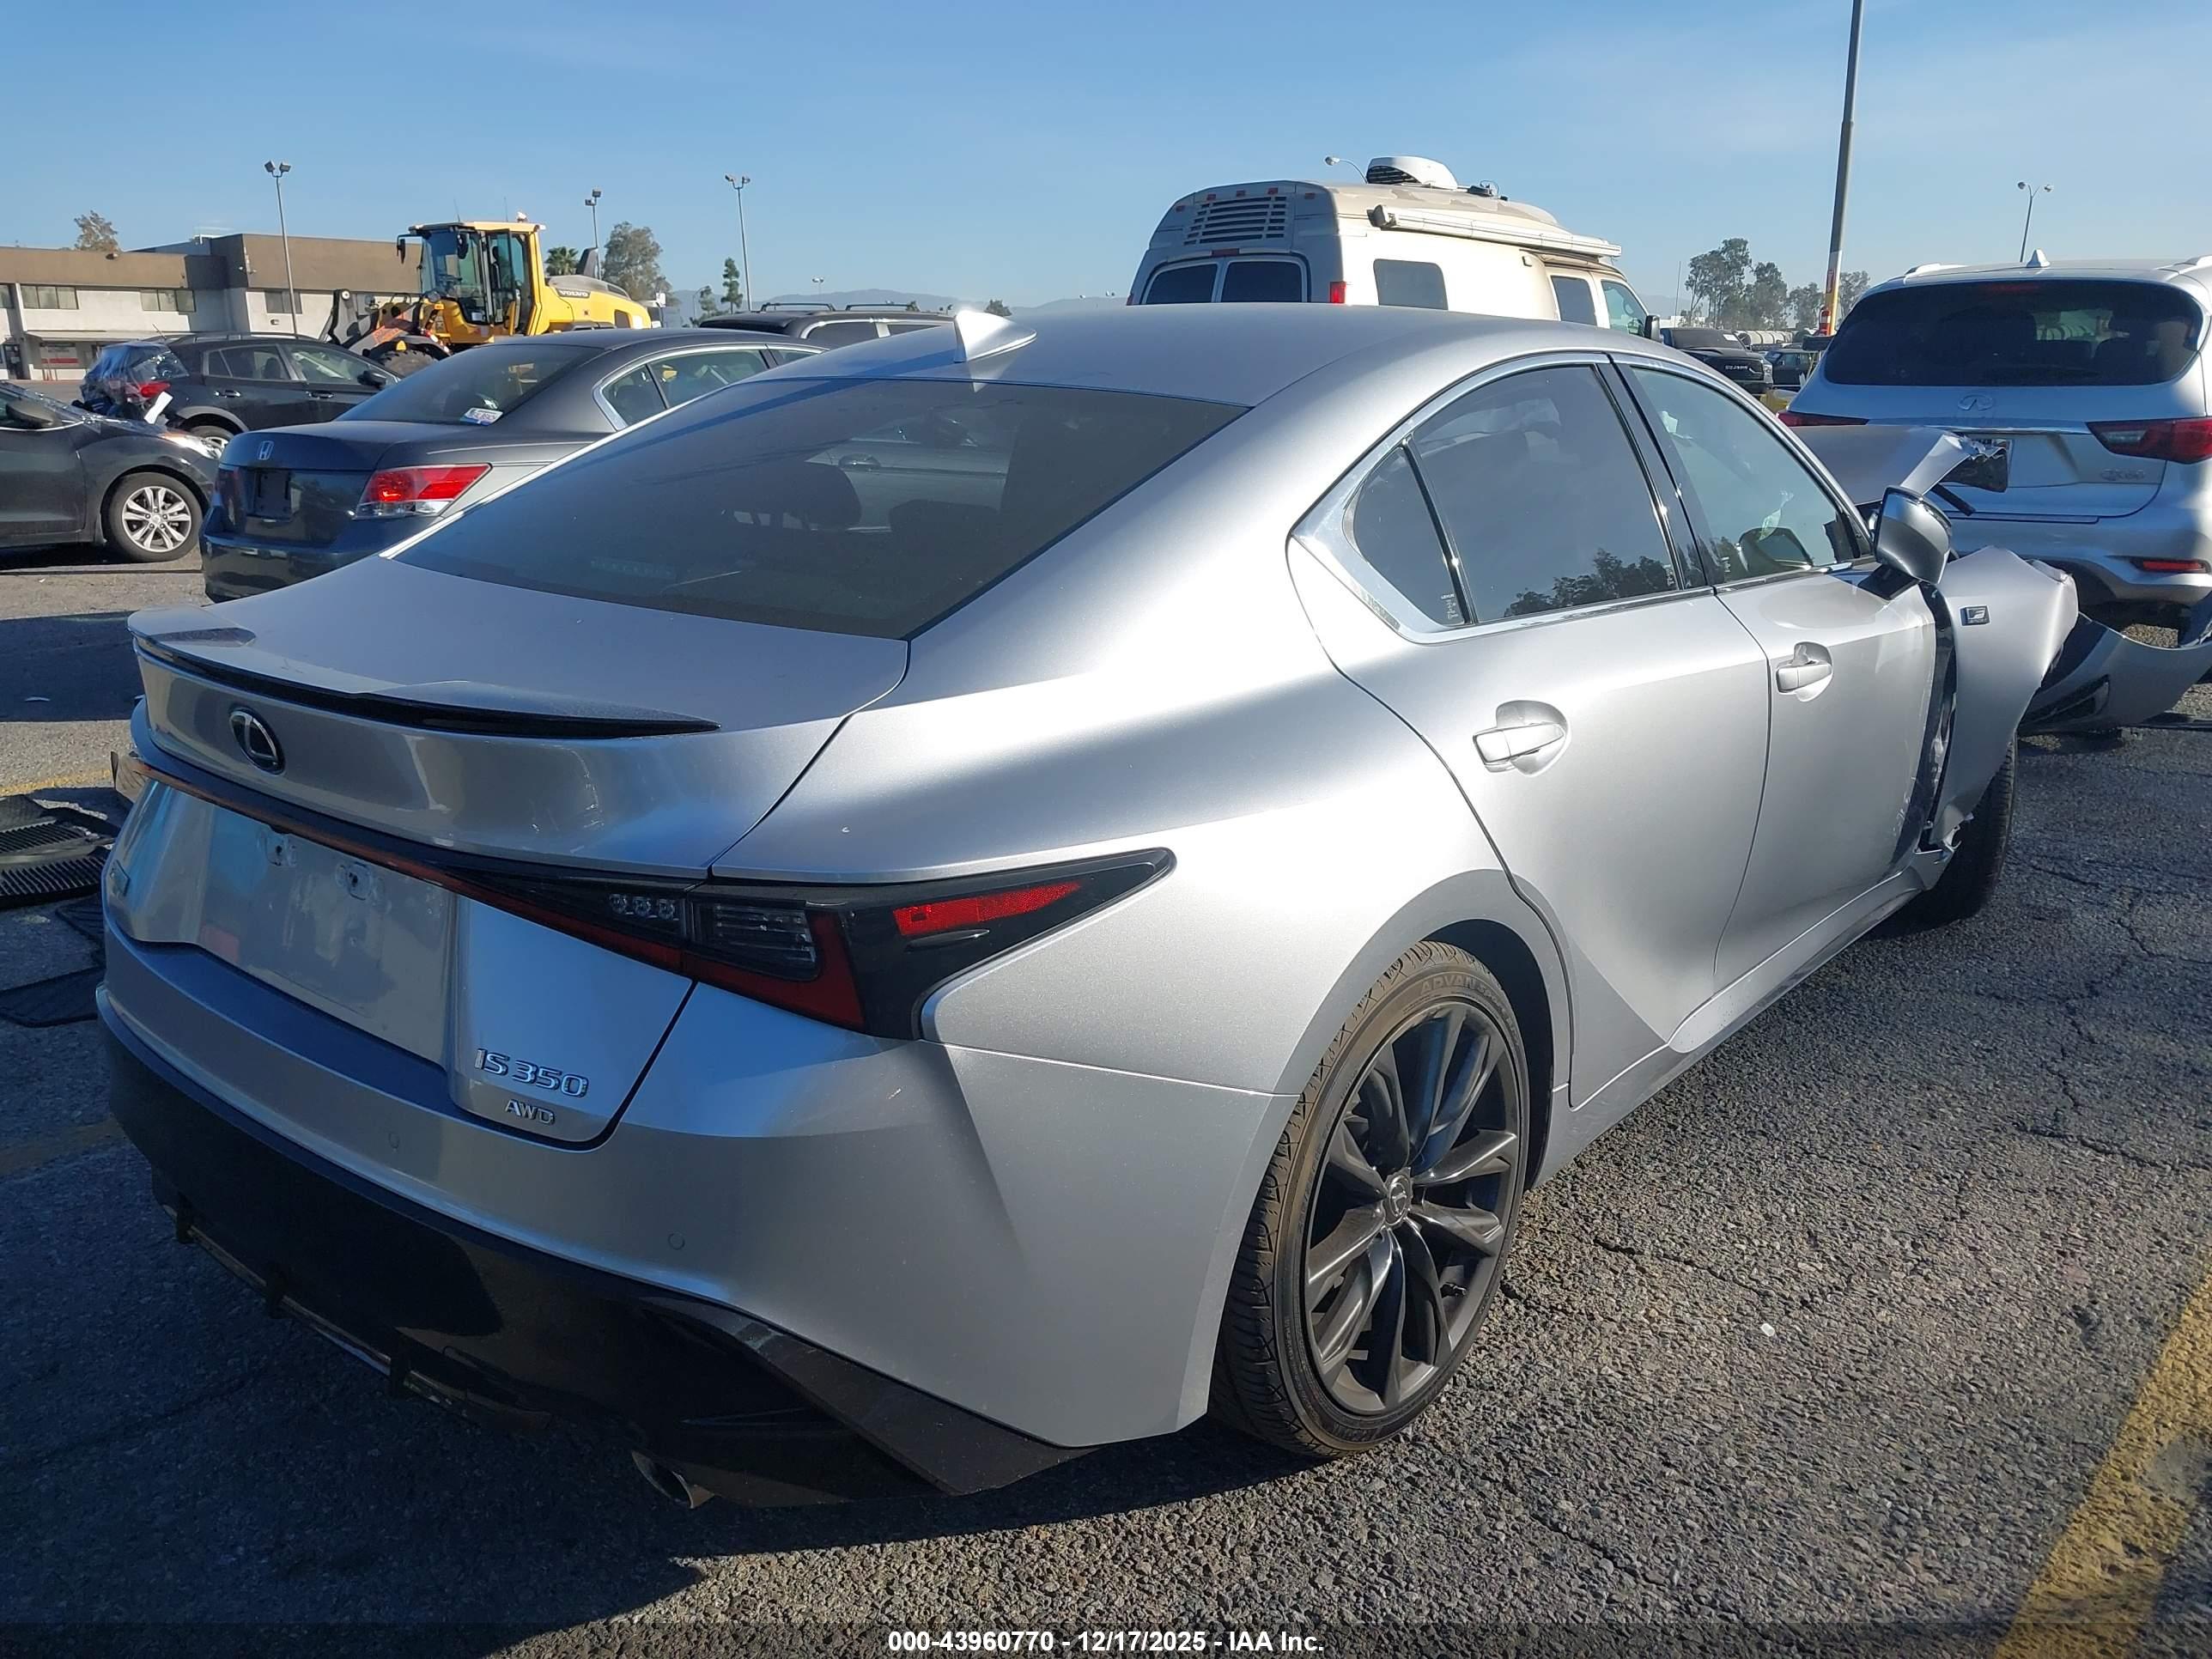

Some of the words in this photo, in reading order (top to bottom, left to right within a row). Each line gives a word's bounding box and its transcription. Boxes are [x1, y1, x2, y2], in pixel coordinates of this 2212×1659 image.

[1420, 975, 1476, 995] ADVAN
[475, 1048, 510, 1075] IS
[513, 1060, 589, 1098] 350
[505, 1100, 556, 1125] AWD
